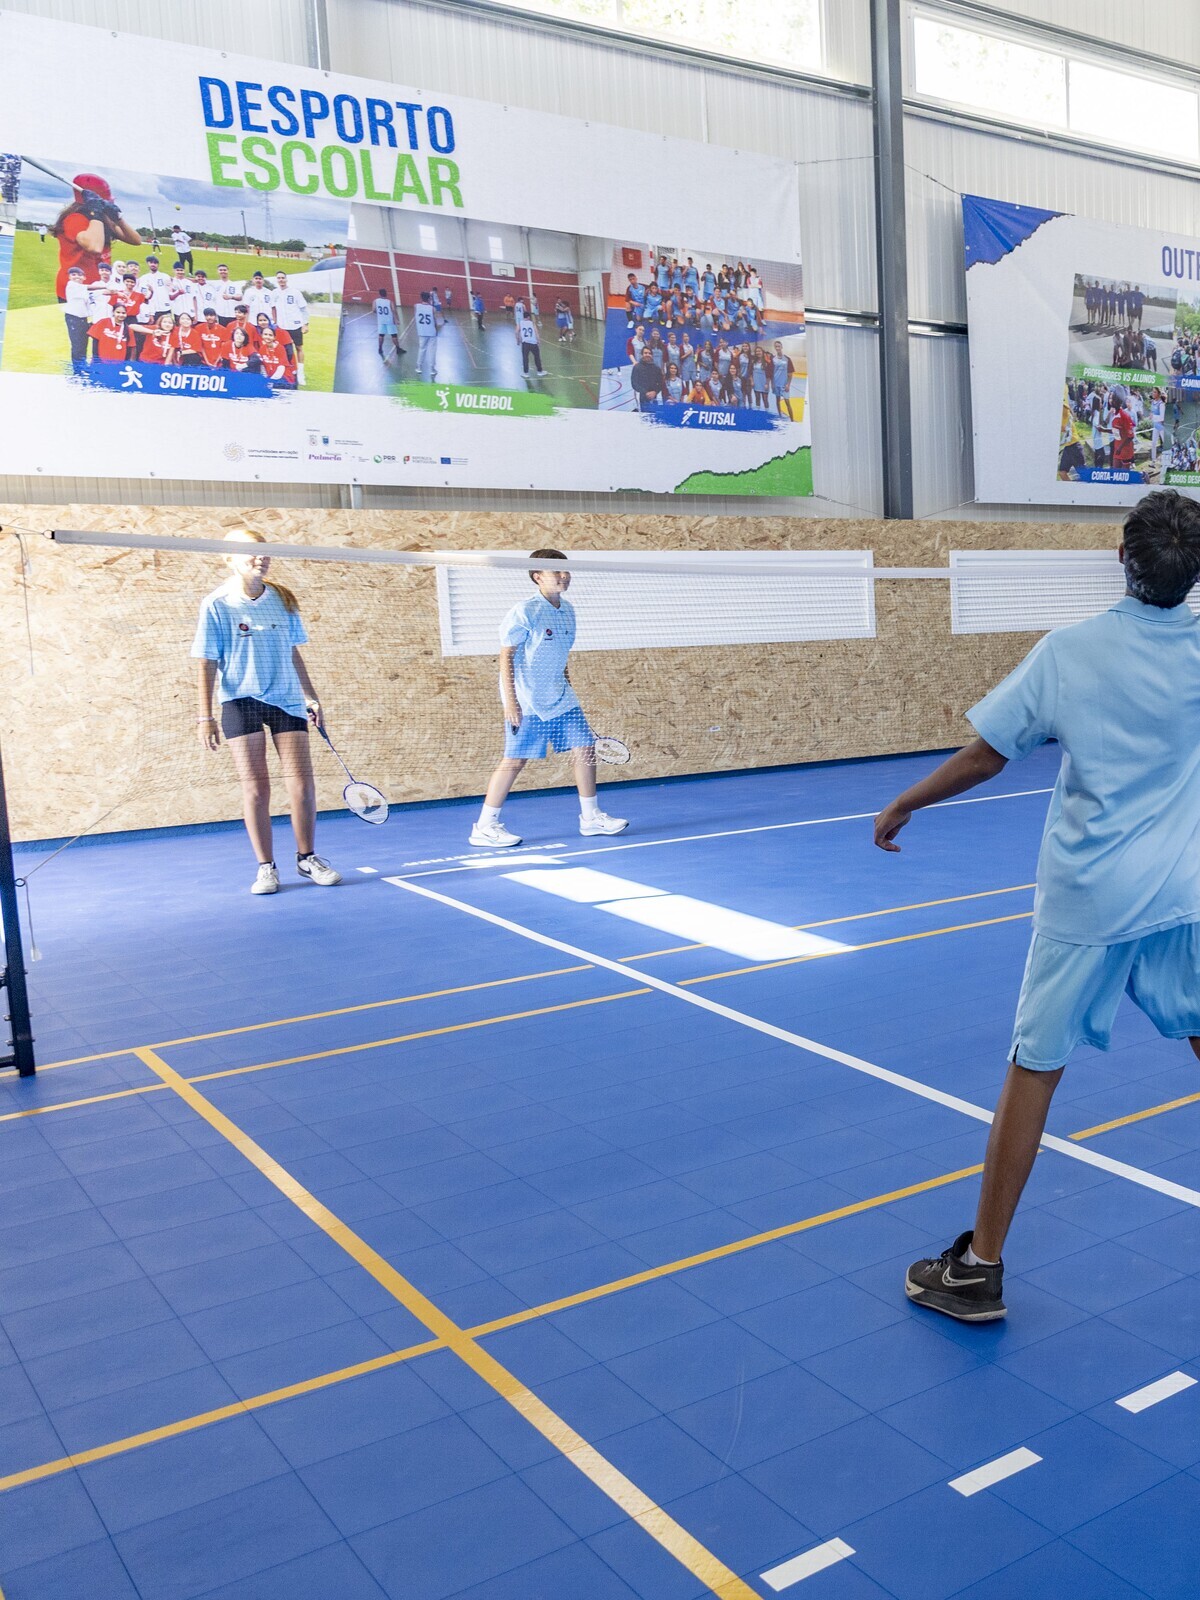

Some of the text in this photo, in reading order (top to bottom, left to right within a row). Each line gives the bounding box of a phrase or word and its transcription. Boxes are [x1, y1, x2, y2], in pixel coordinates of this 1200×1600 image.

[198, 76, 456, 154] DESPORTO
[206, 132, 464, 208] ESCOLAR
[378, 306, 389, 316] 30
[418, 313, 431, 325] 25
[522, 327, 533, 338] 29
[159, 372, 228, 392] SOFTBOL
[1083, 368, 1156, 384] PROFESSORES VS ALUNOS
[455, 393, 514, 411] VOLEIBOL
[698, 412, 736, 426] FUTSAL
[1091, 471, 1130, 482] CORTA-MATO
[1169, 474, 1187, 484] JOGOS
